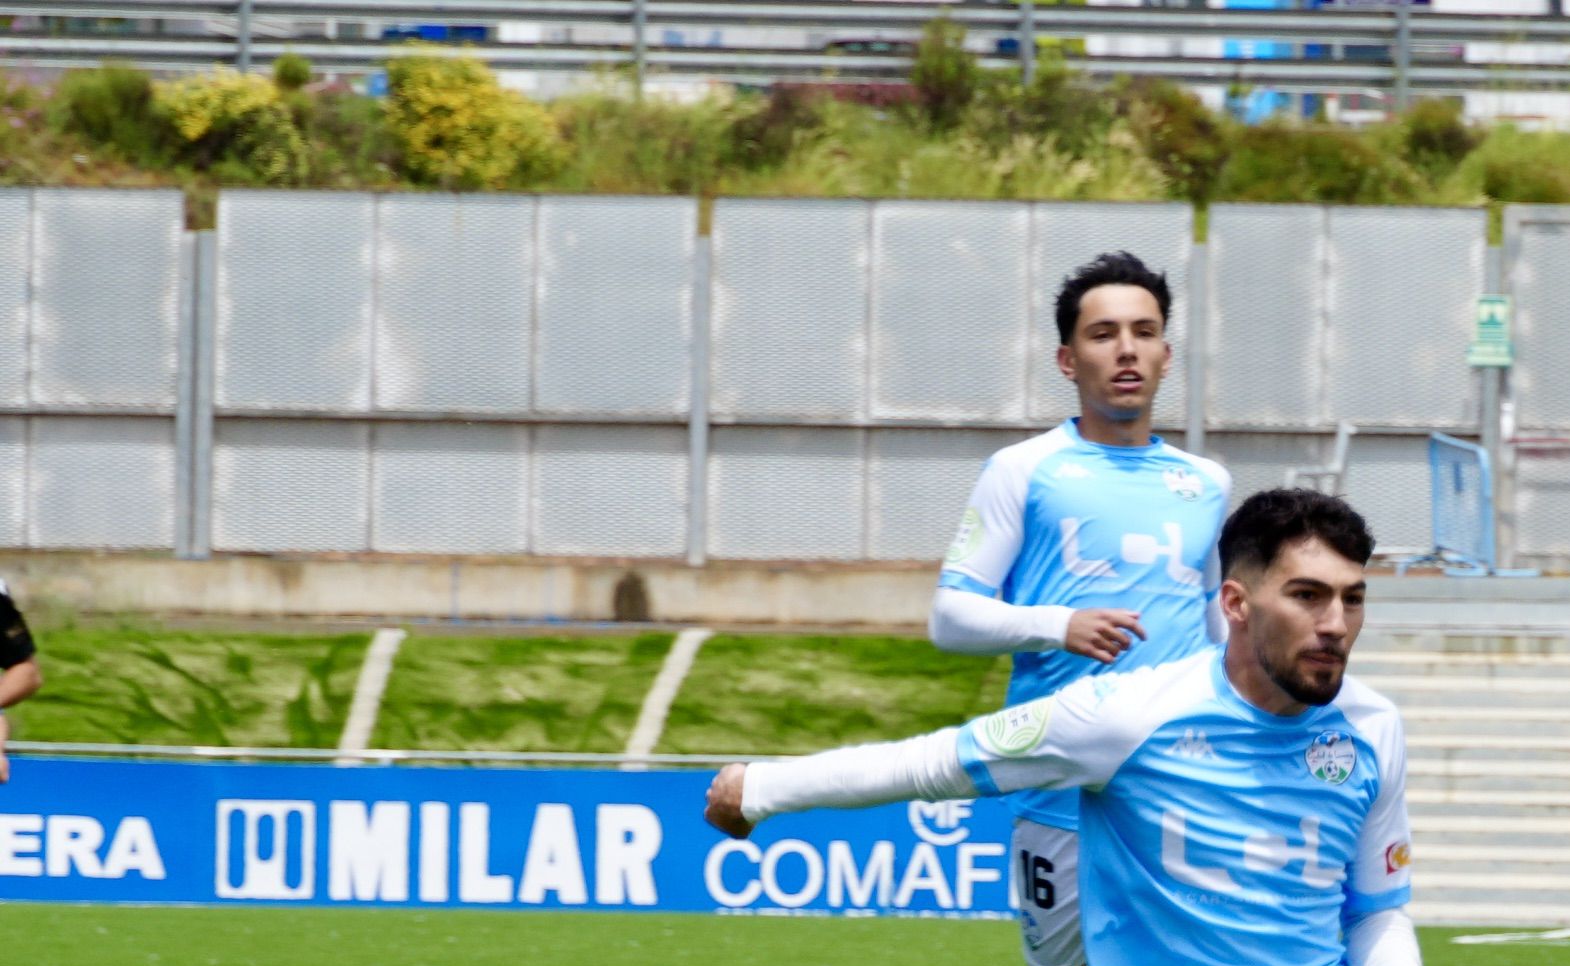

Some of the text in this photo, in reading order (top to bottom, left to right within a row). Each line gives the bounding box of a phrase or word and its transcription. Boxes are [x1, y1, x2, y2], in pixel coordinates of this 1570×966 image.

[327, 800, 663, 905] MILAR
[704, 838, 1020, 909] COMAF
[1021, 849, 1055, 910] 16
